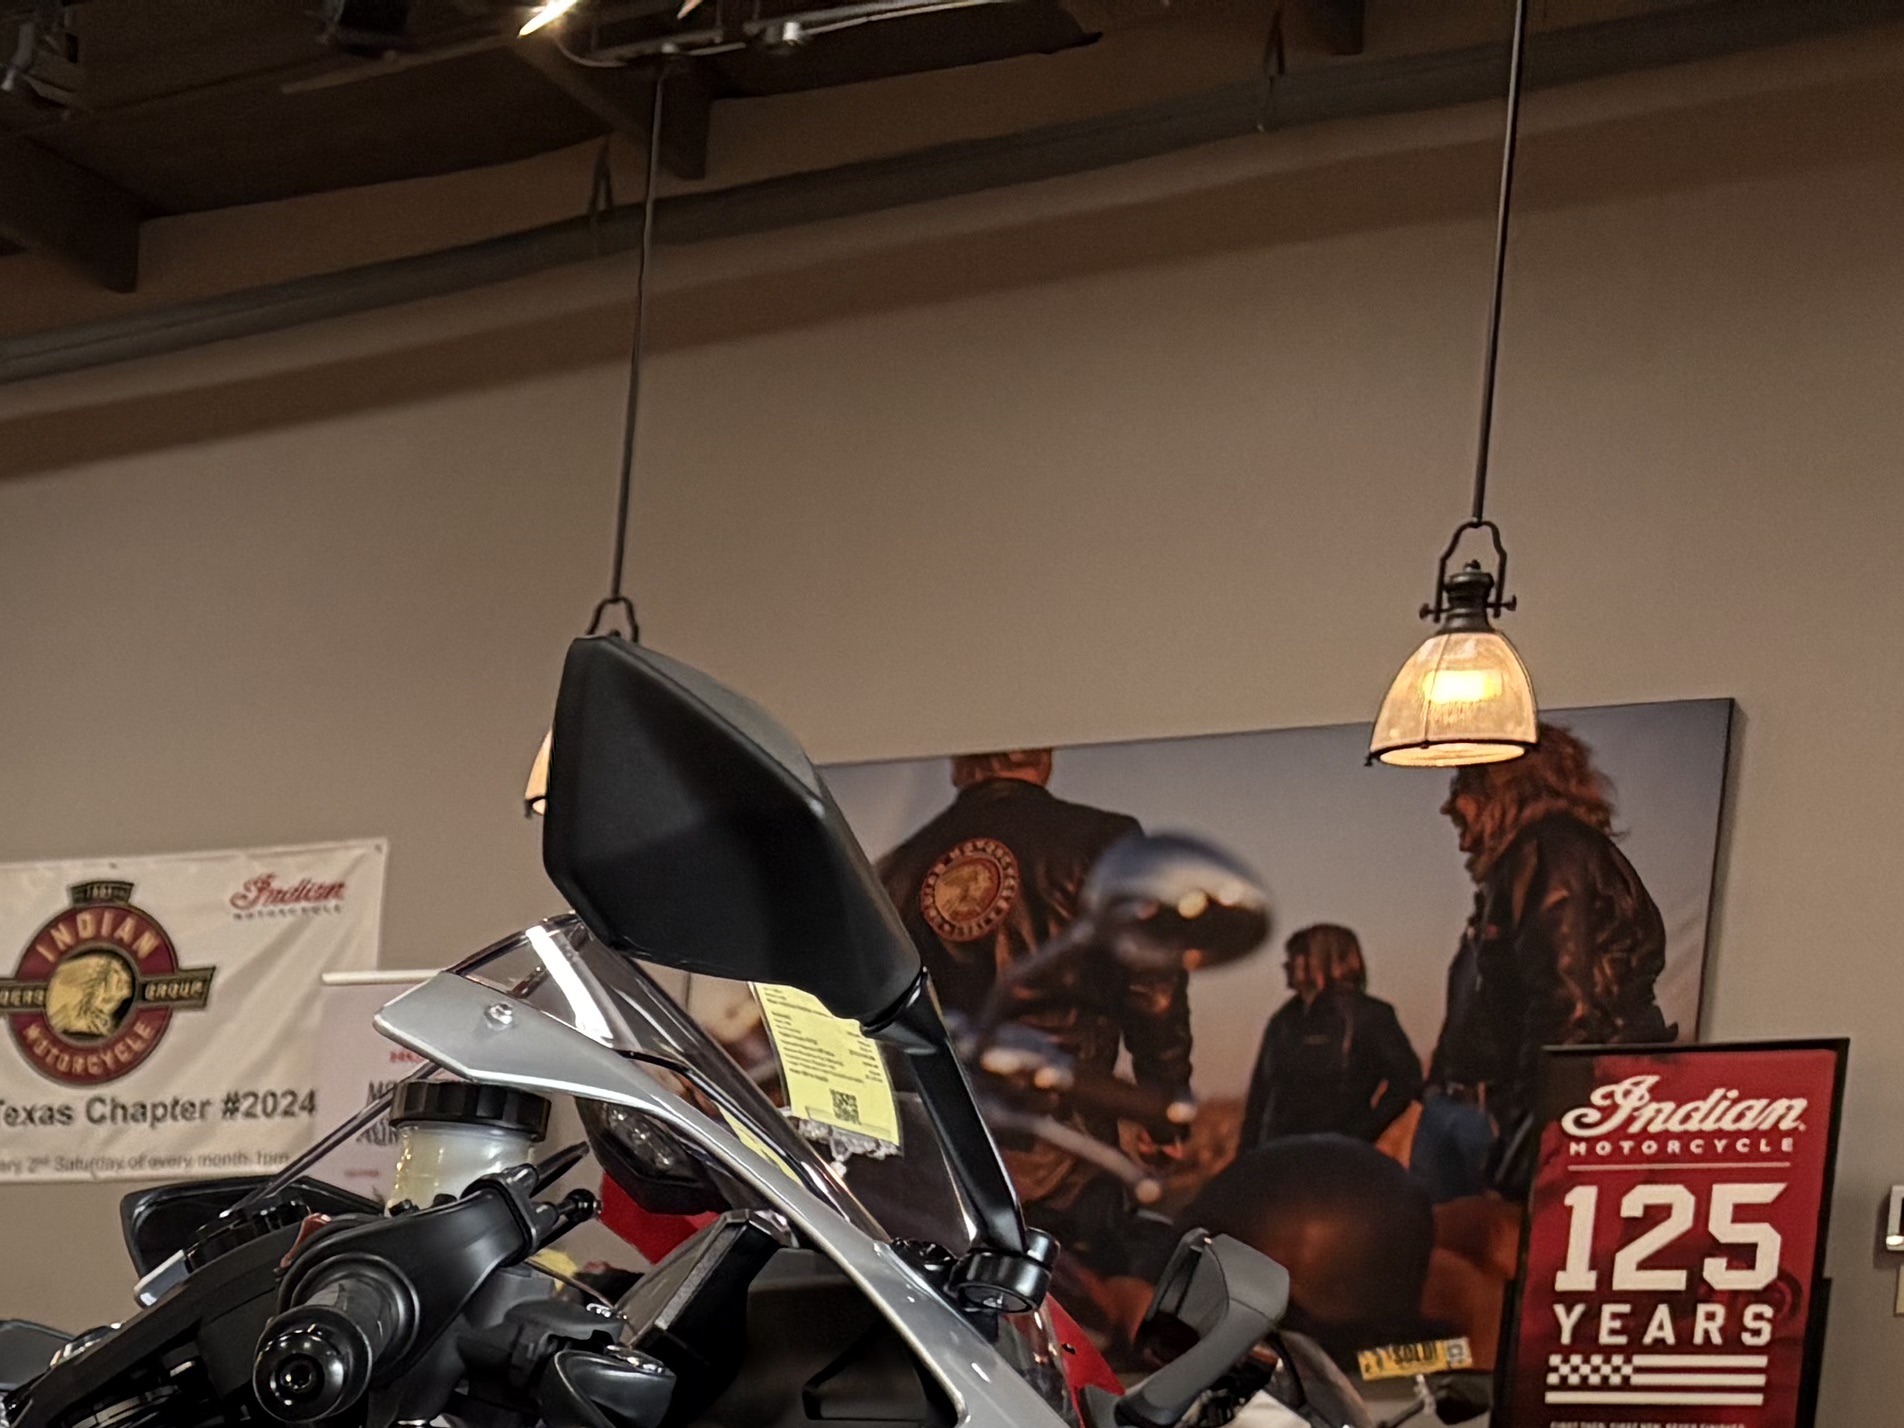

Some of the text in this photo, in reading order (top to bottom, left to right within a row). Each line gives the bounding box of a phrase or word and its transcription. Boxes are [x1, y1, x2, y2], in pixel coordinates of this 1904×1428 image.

[36, 910, 161, 962] INDIAN
[144, 980, 203, 999] GROUP
[22, 1022, 156, 1076] MOTORCYCLE
[85, 1096, 211, 1129] Chapter
[221, 1088, 317, 1120] #2024
[1560, 1074, 1809, 1138] Indian
[1569, 1137, 1794, 1157] MOTORCYCLE
[1554, 1182, 1789, 1291] 125
[1553, 1303, 1774, 1347] YEARS
